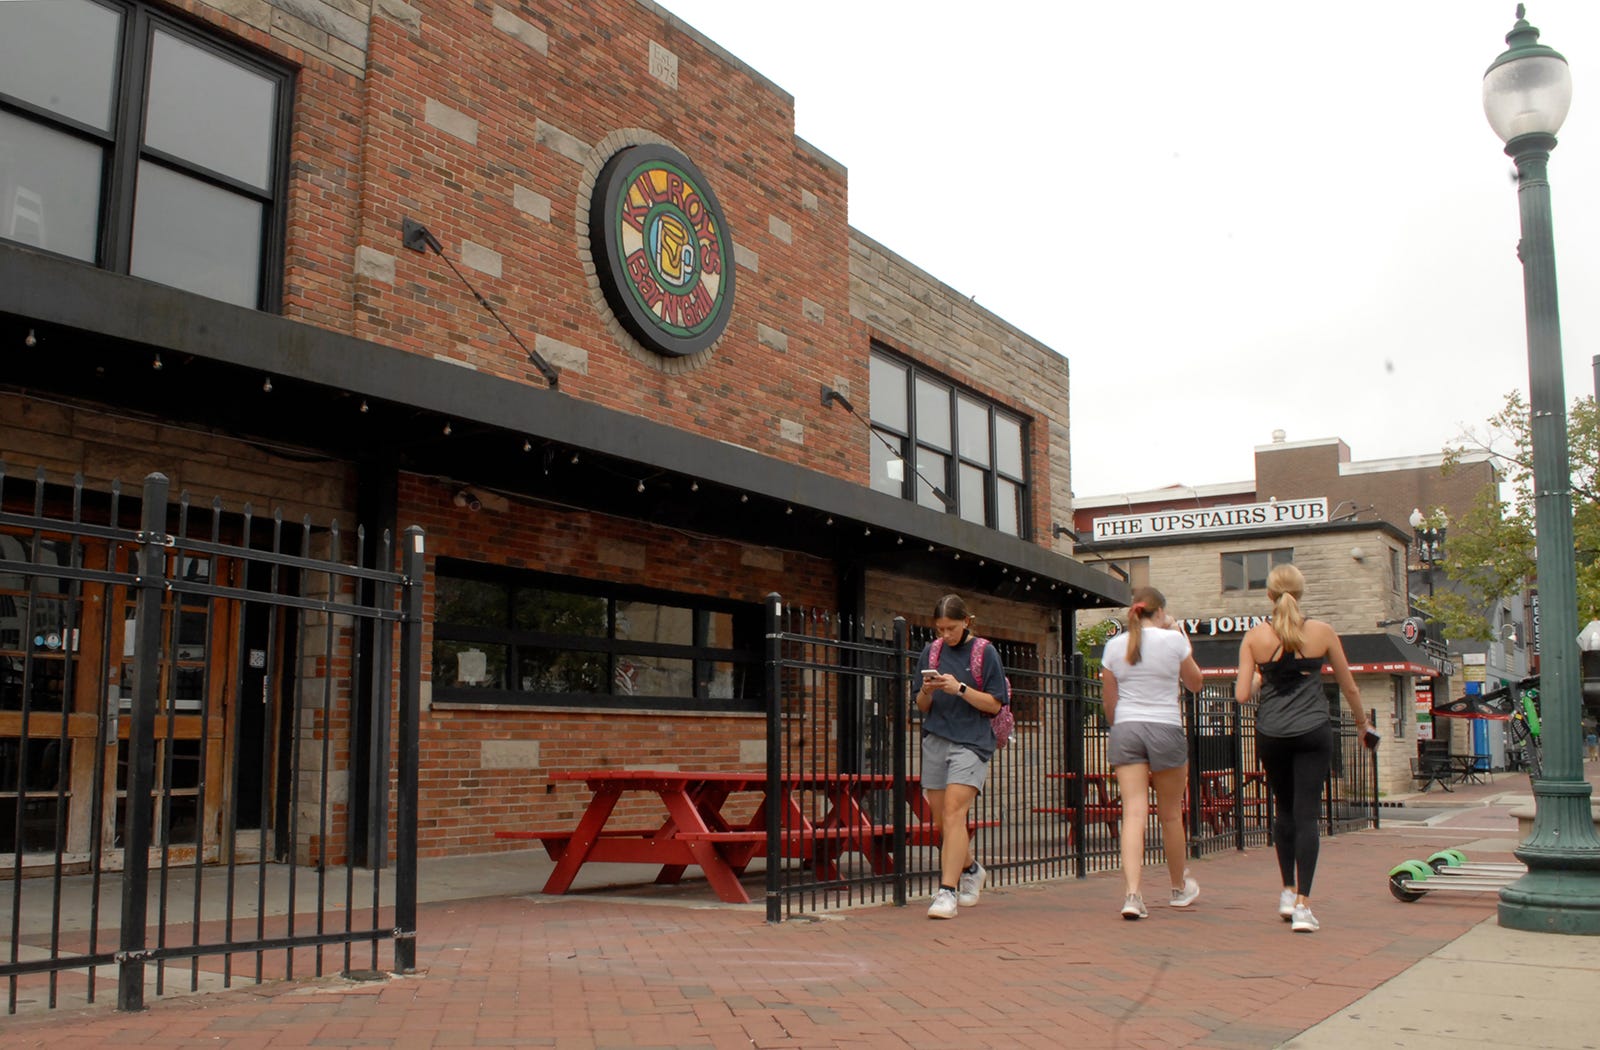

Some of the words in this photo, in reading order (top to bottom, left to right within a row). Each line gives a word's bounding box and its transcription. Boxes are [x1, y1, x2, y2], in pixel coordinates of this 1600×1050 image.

[622, 171, 721, 275] KILROY'S
[1097, 518, 1143, 537] THE
[1150, 507, 1267, 532] UPSTAIRS
[1274, 502, 1324, 522] PUB
